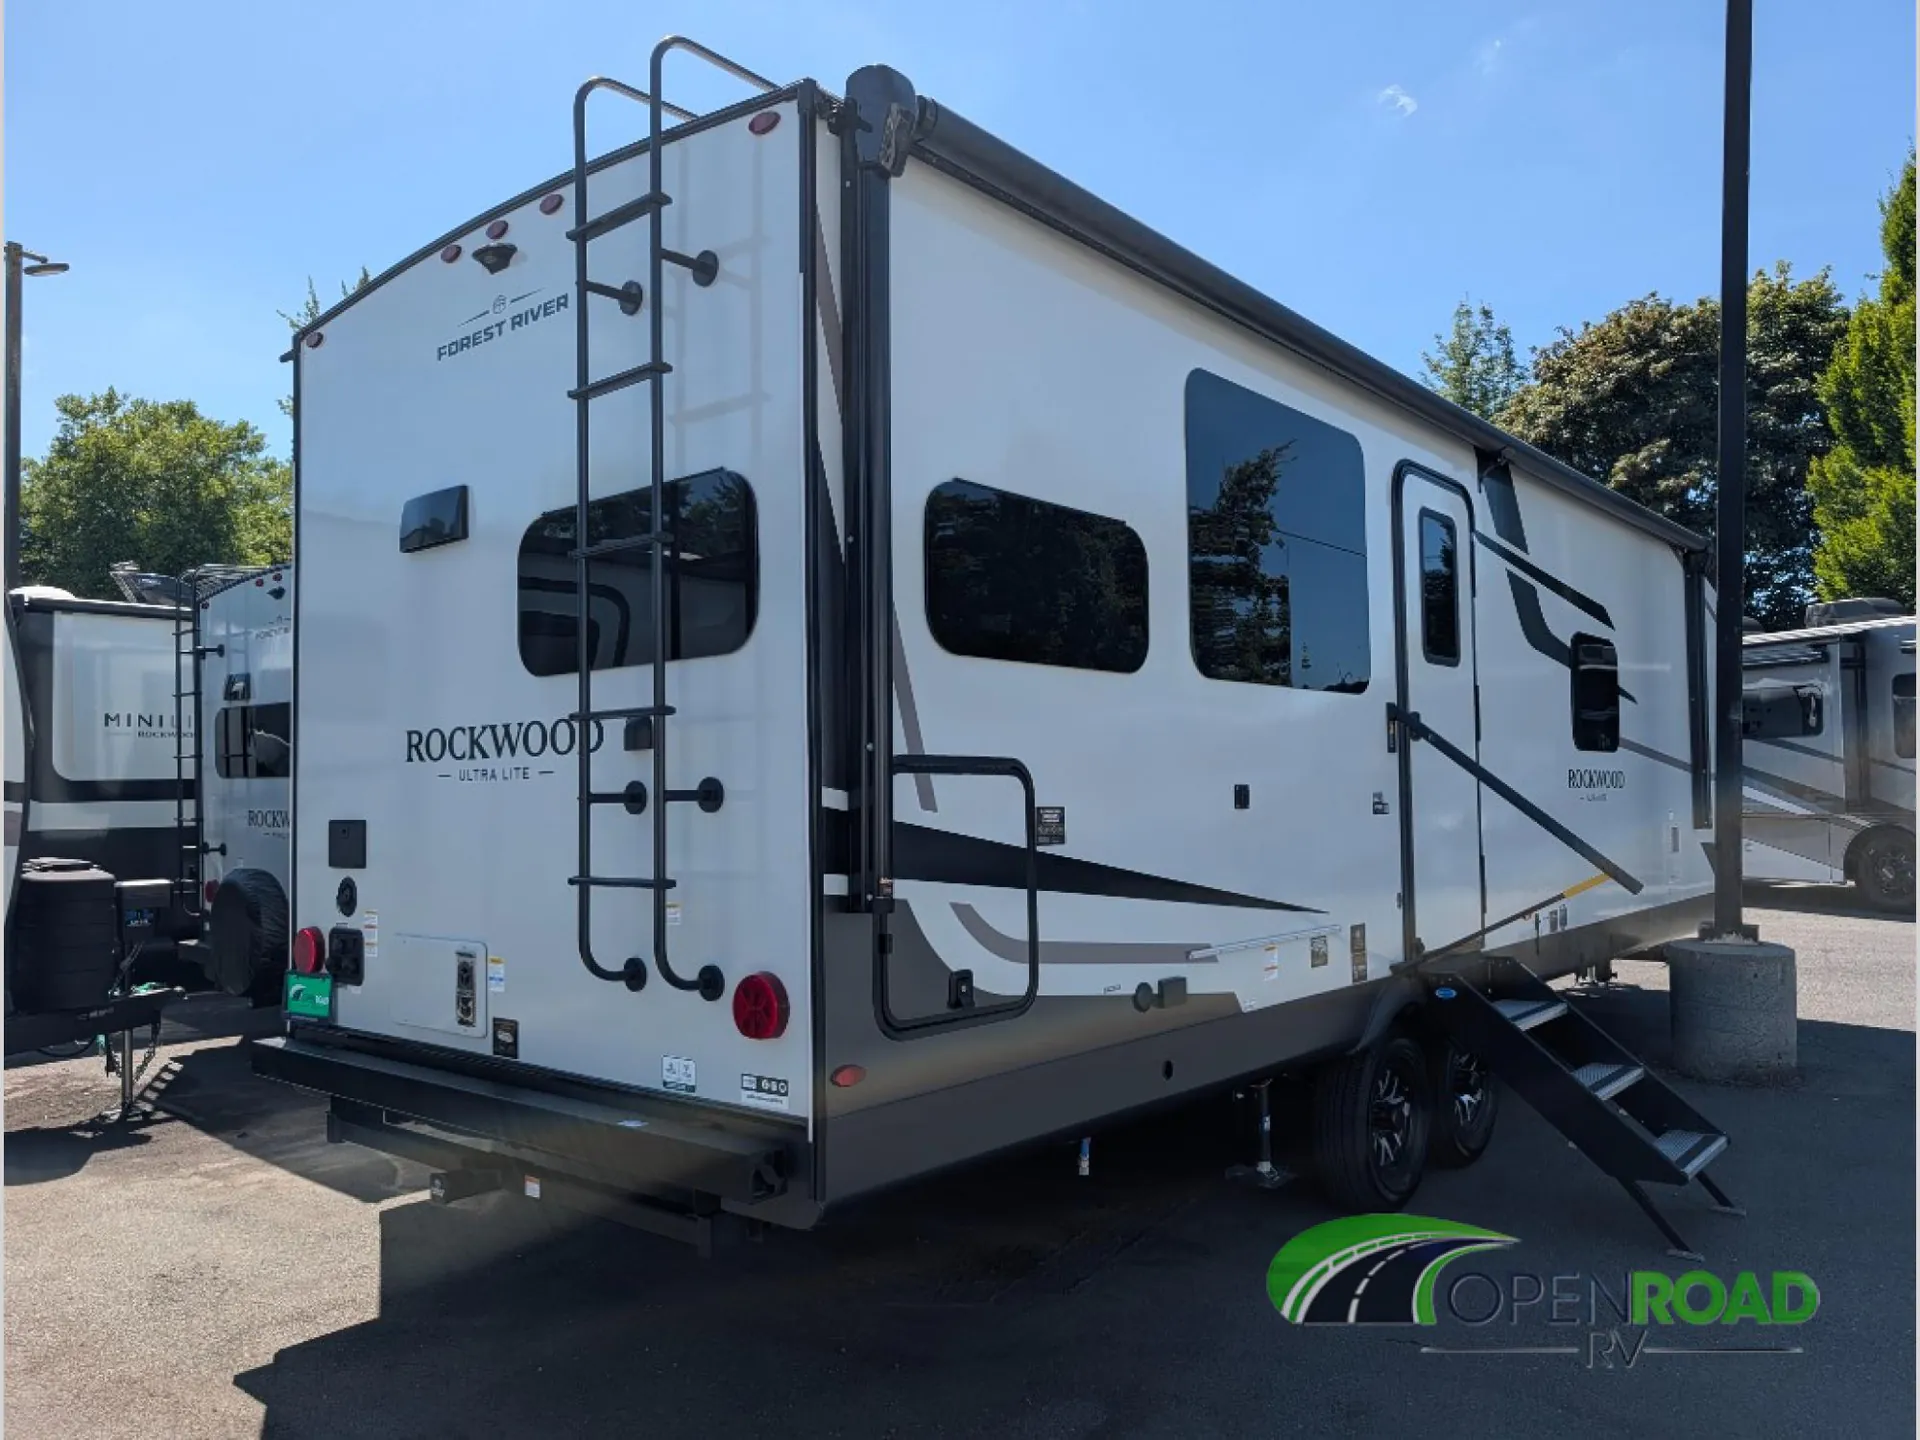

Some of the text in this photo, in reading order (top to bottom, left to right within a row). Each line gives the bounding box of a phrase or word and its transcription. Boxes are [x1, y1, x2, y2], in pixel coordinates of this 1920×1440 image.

[436, 292, 570, 362] FOREST RIVER
[458, 766, 531, 782] ULTRA LITE
[1567, 768, 1627, 790] ROCKWOOD
